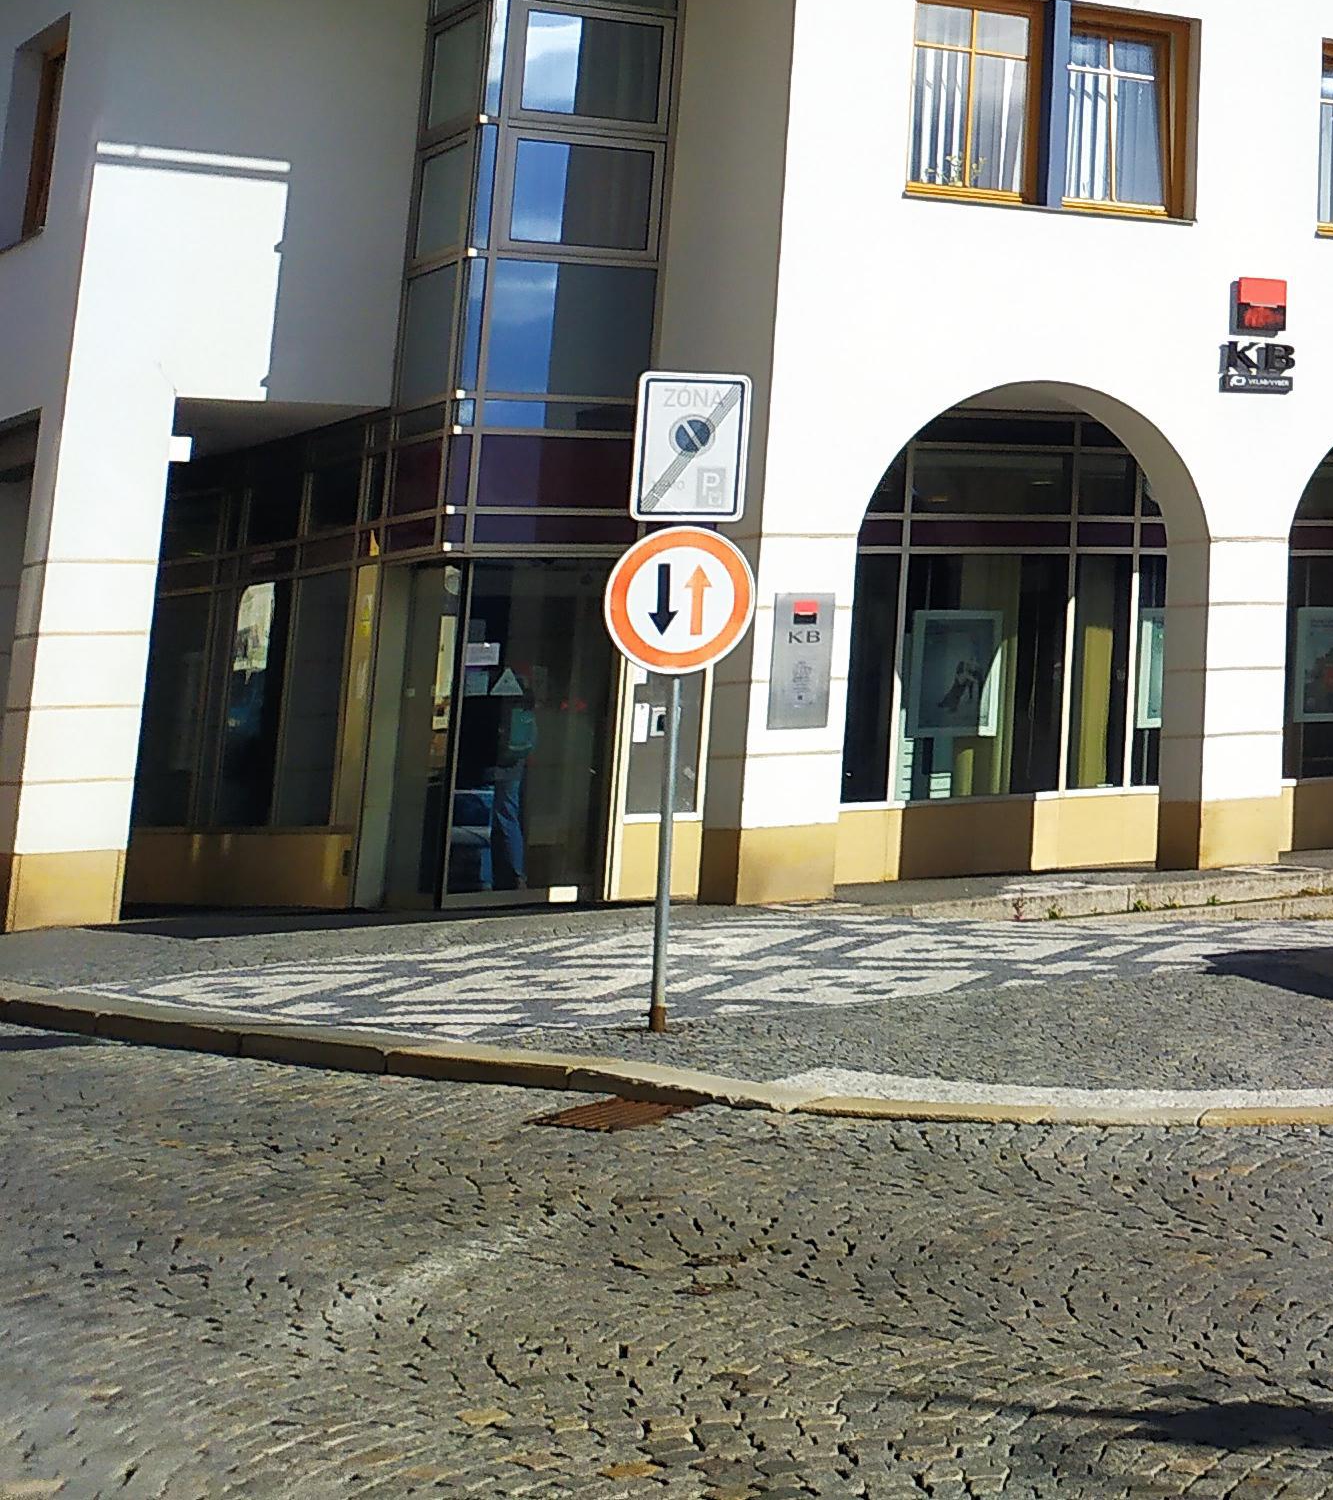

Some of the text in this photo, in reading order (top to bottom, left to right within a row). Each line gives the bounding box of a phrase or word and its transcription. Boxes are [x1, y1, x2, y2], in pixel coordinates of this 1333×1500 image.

[1227, 340, 1296, 371] KB
[663, 385, 724, 408] ZÓNA
[788, 630, 821, 644] KB
